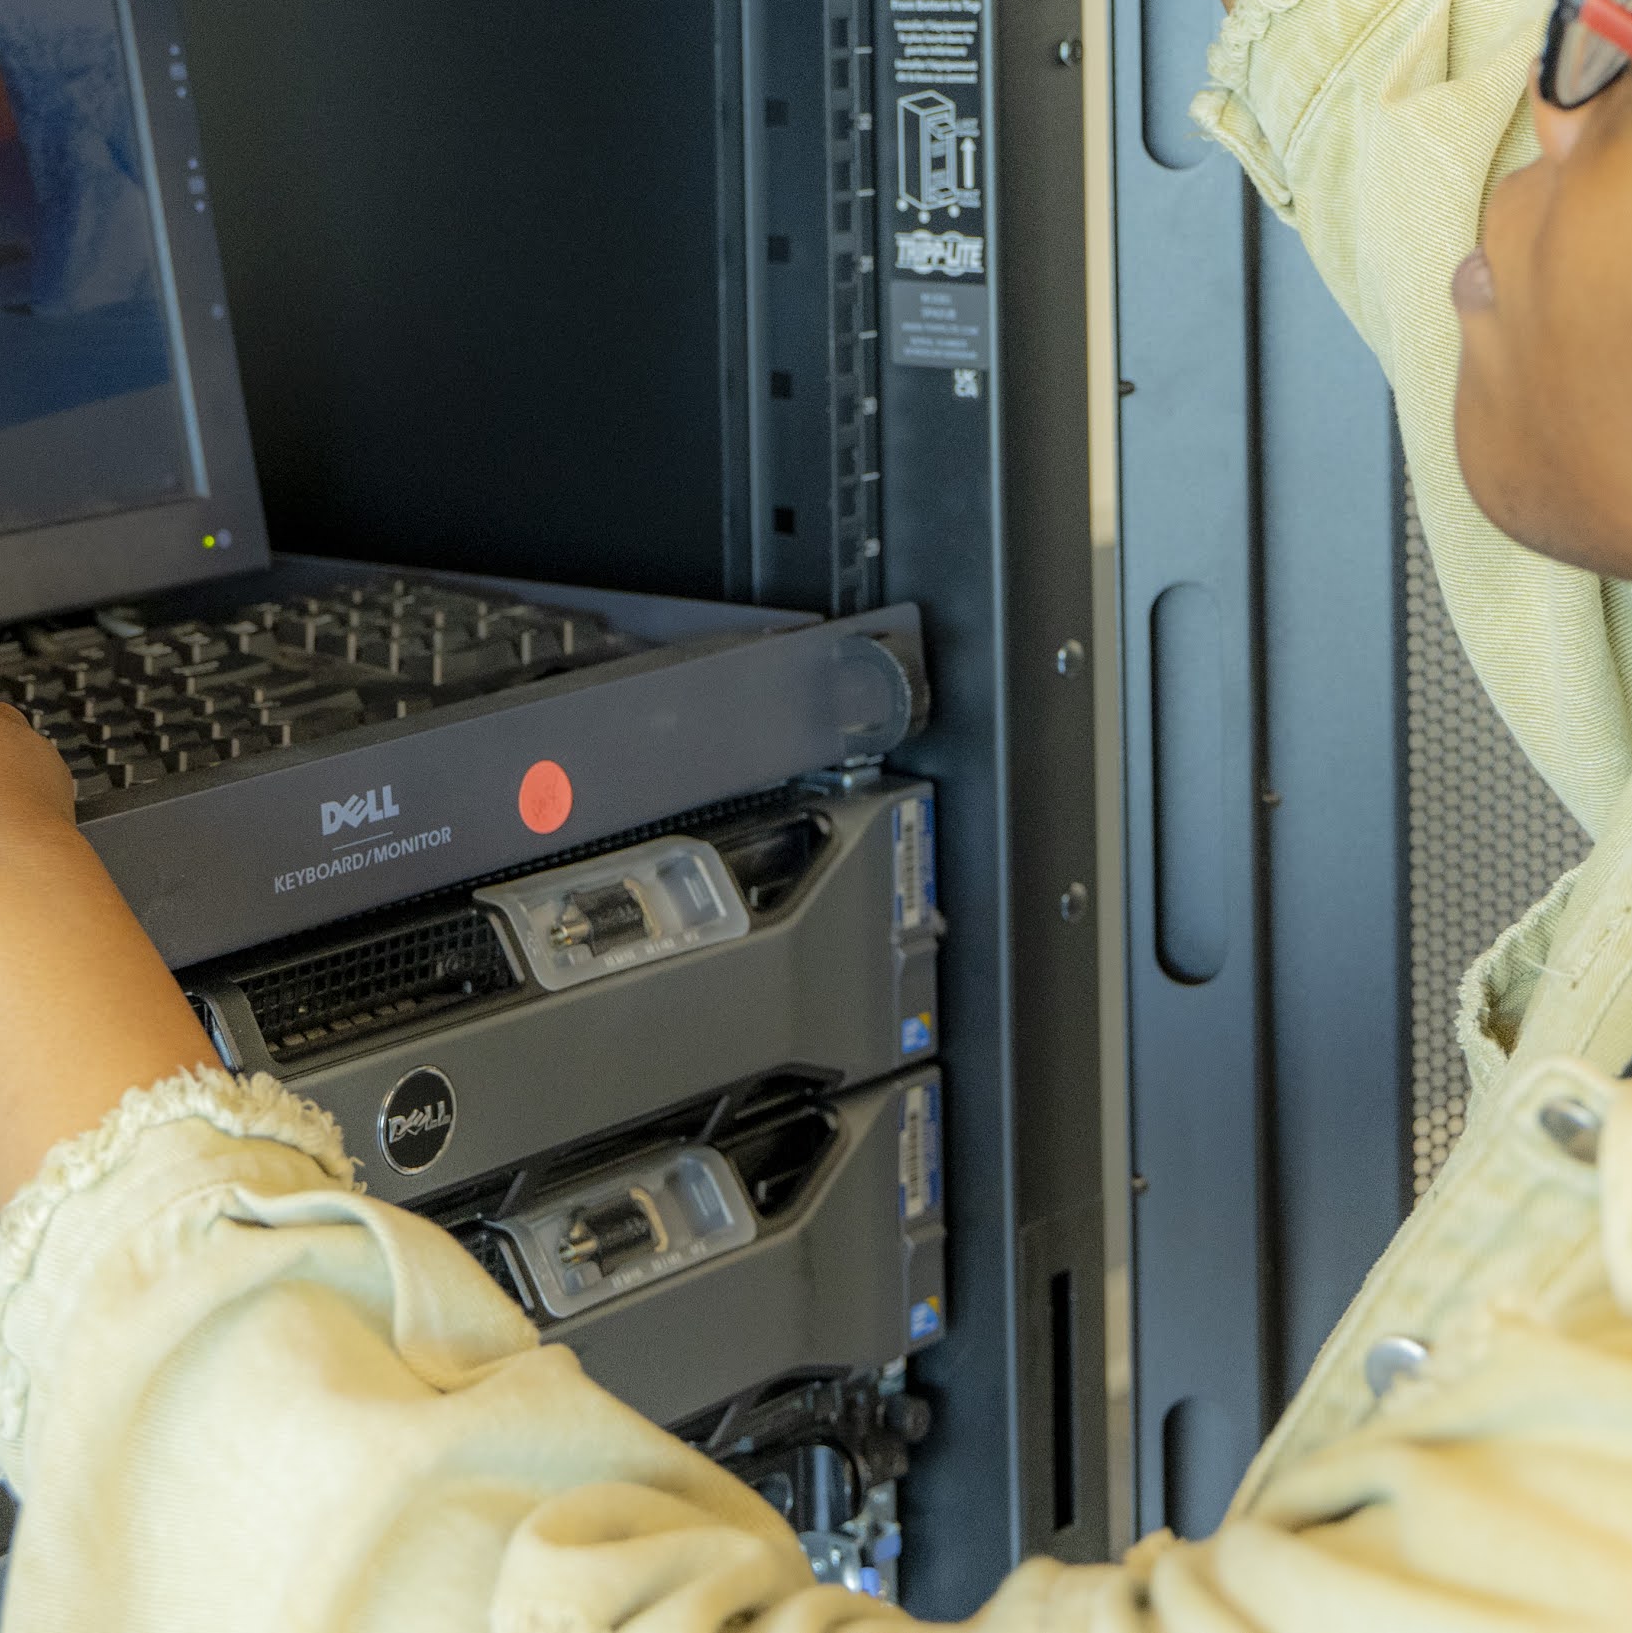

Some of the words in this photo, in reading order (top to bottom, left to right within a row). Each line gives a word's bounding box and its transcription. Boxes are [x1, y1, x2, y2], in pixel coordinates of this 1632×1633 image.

[320, 784, 400, 836] DELL
[274, 826, 452, 895] KEYBOARD/MONITOR
[388, 1100, 451, 1144] DELL
